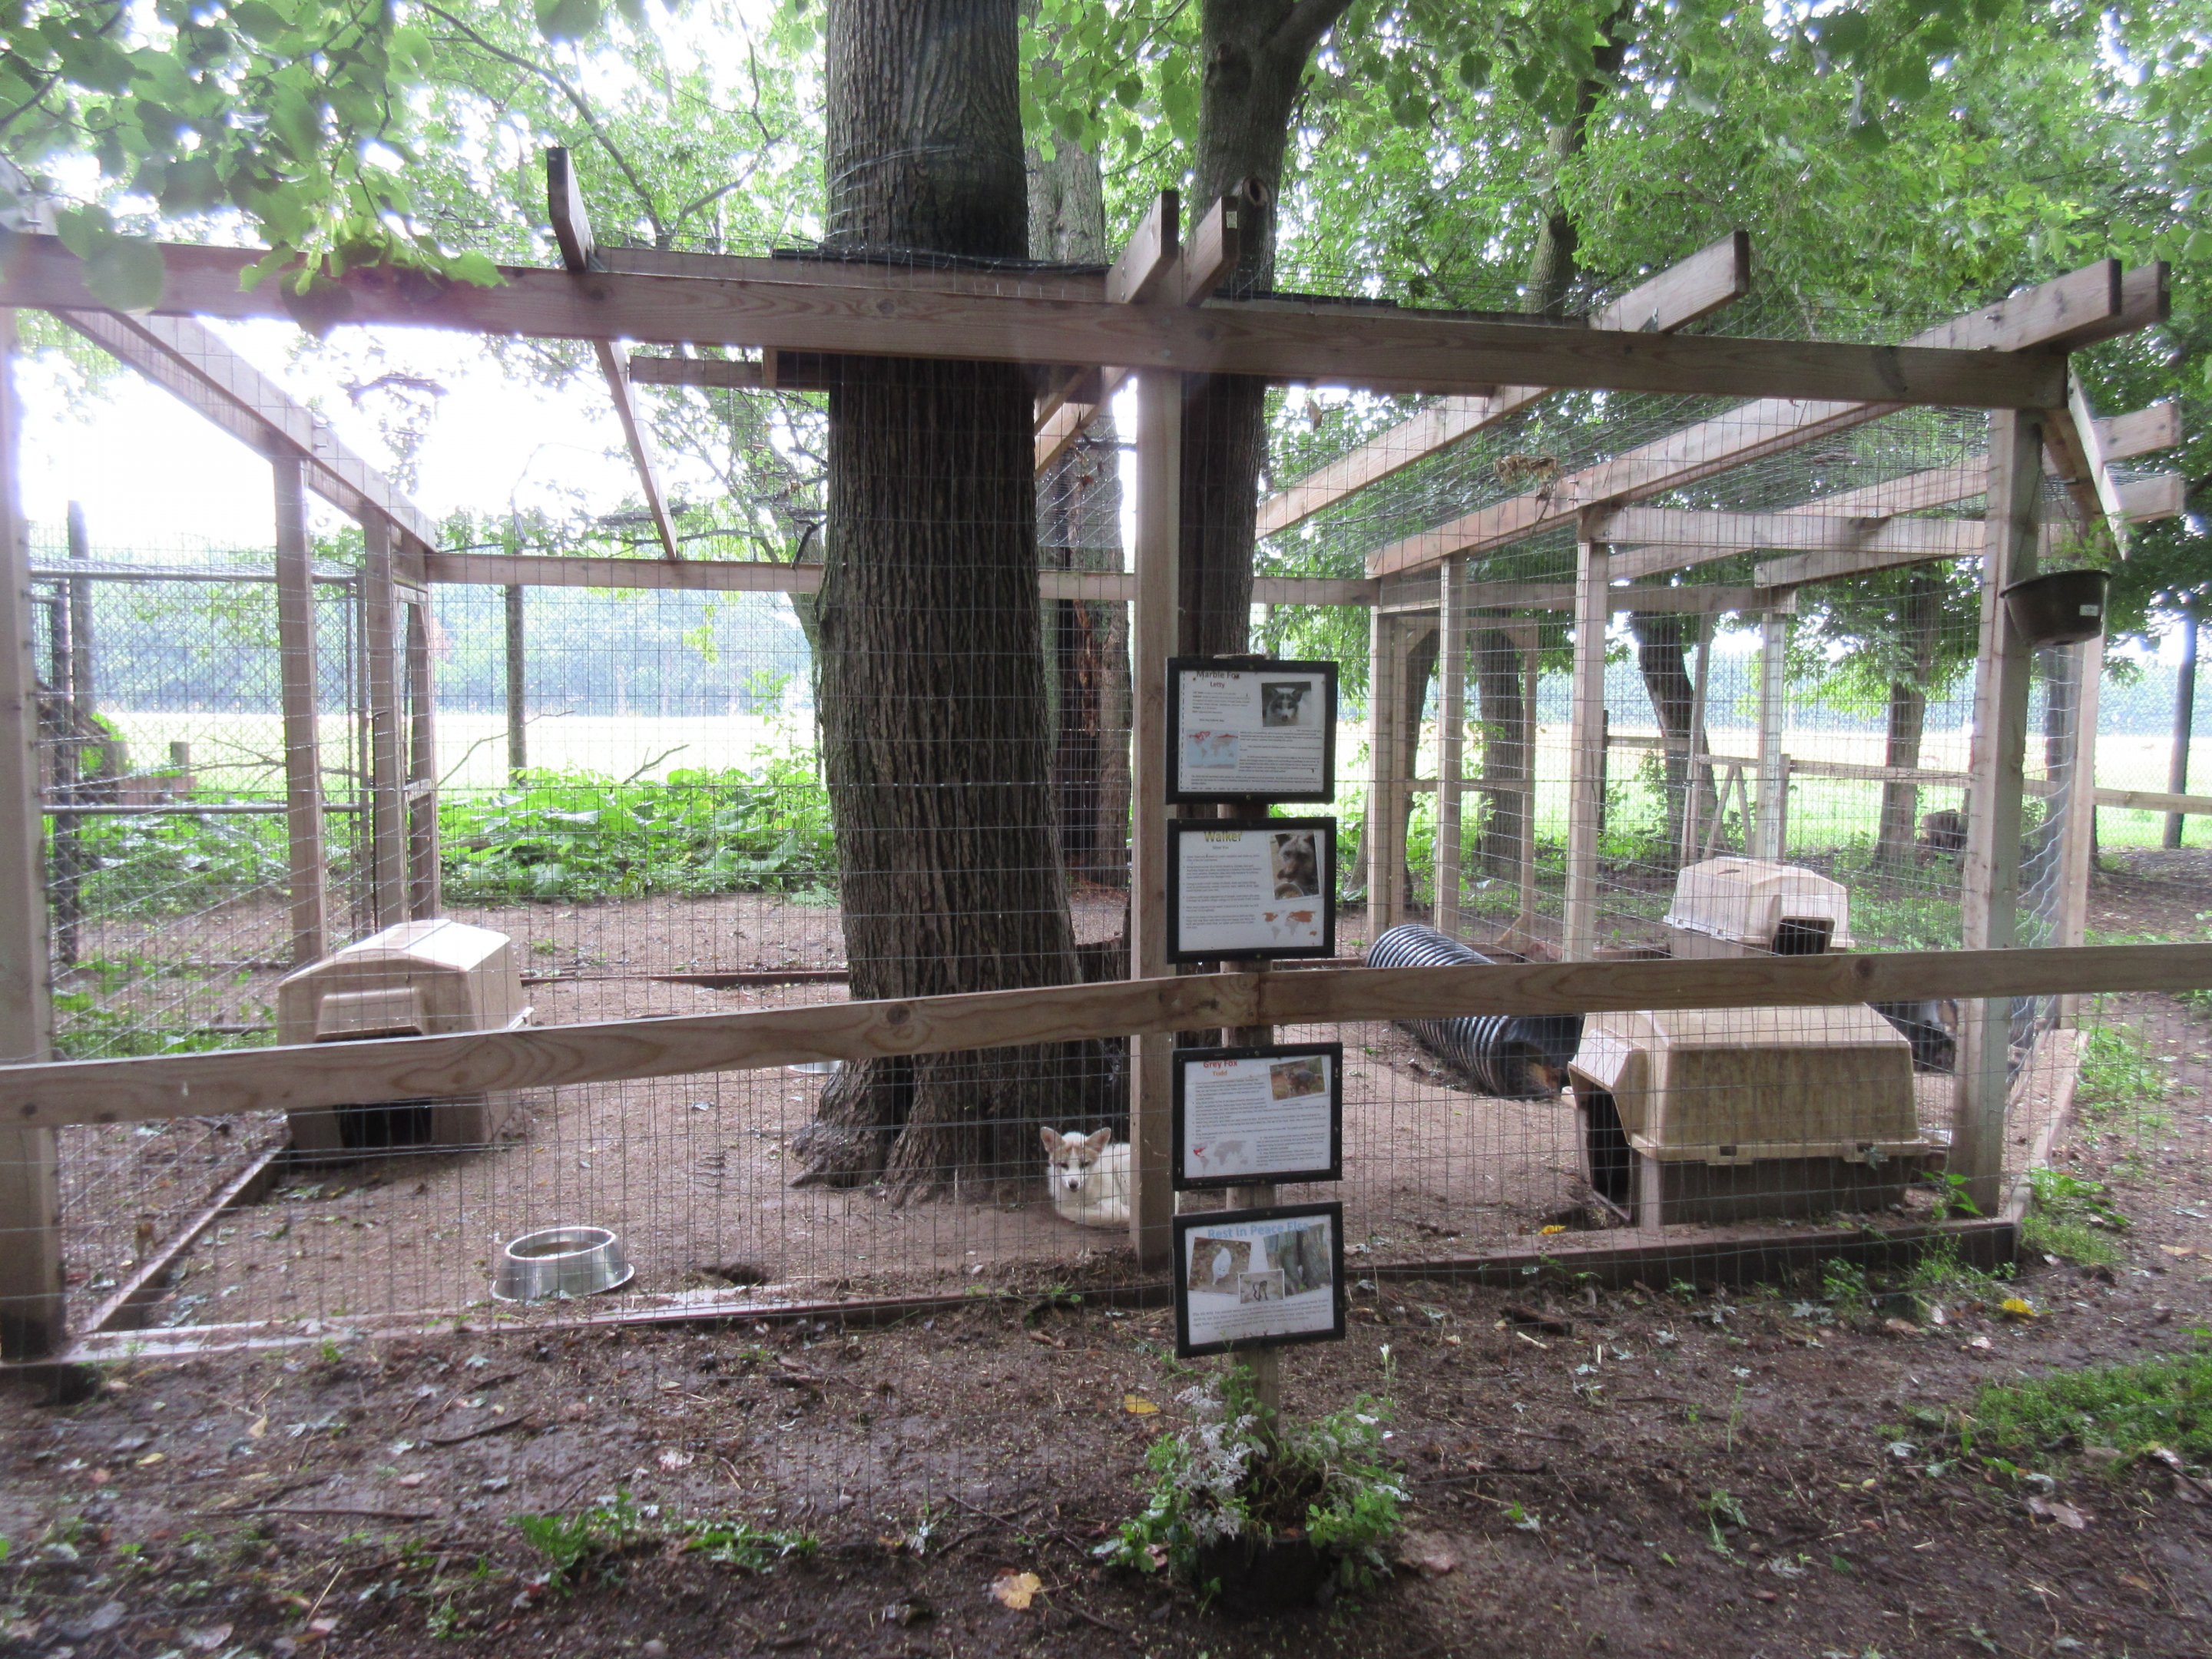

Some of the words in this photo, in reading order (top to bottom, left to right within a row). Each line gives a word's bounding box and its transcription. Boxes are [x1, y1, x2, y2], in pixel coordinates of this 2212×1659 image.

[1204, 830, 1242, 843] Walker
[1203, 1061, 1221, 1069] Grey
[1207, 1228, 1233, 1239] Rest
[1250, 1224, 1284, 1236] Peace
